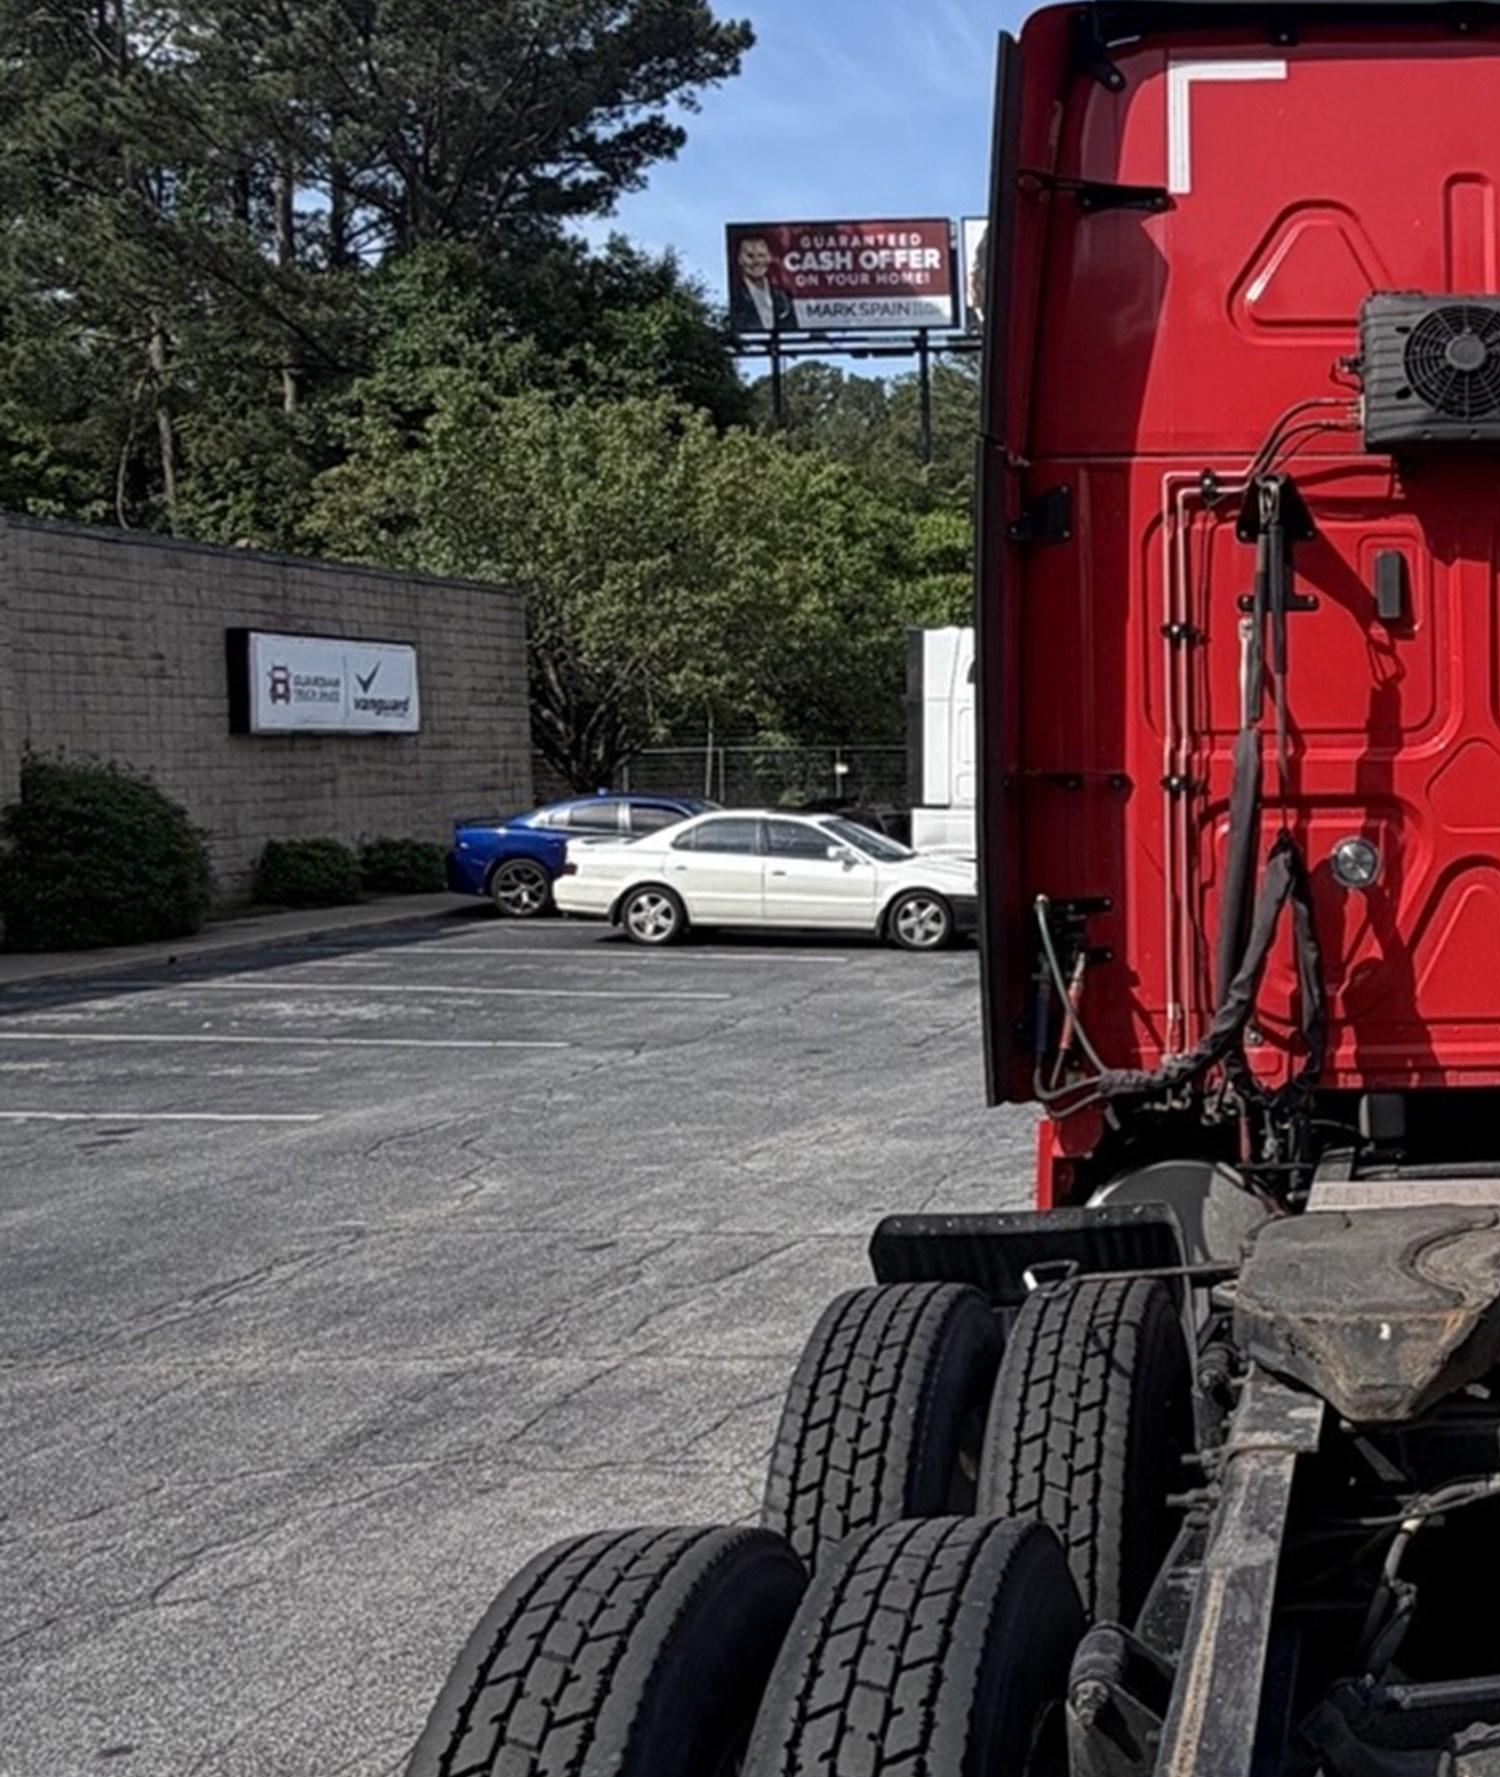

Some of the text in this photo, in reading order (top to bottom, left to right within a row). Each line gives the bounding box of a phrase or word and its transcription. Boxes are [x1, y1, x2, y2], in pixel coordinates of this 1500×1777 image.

[800, 233, 922, 248] GUARANTEED
[783, 248, 941, 271] CASH OFFER
[795, 272, 931, 286] ON YOUR HOME!
[806, 302, 857, 317] MARK
[859, 301, 910, 316] SPAIN
[353, 696, 410, 716] vanguard
